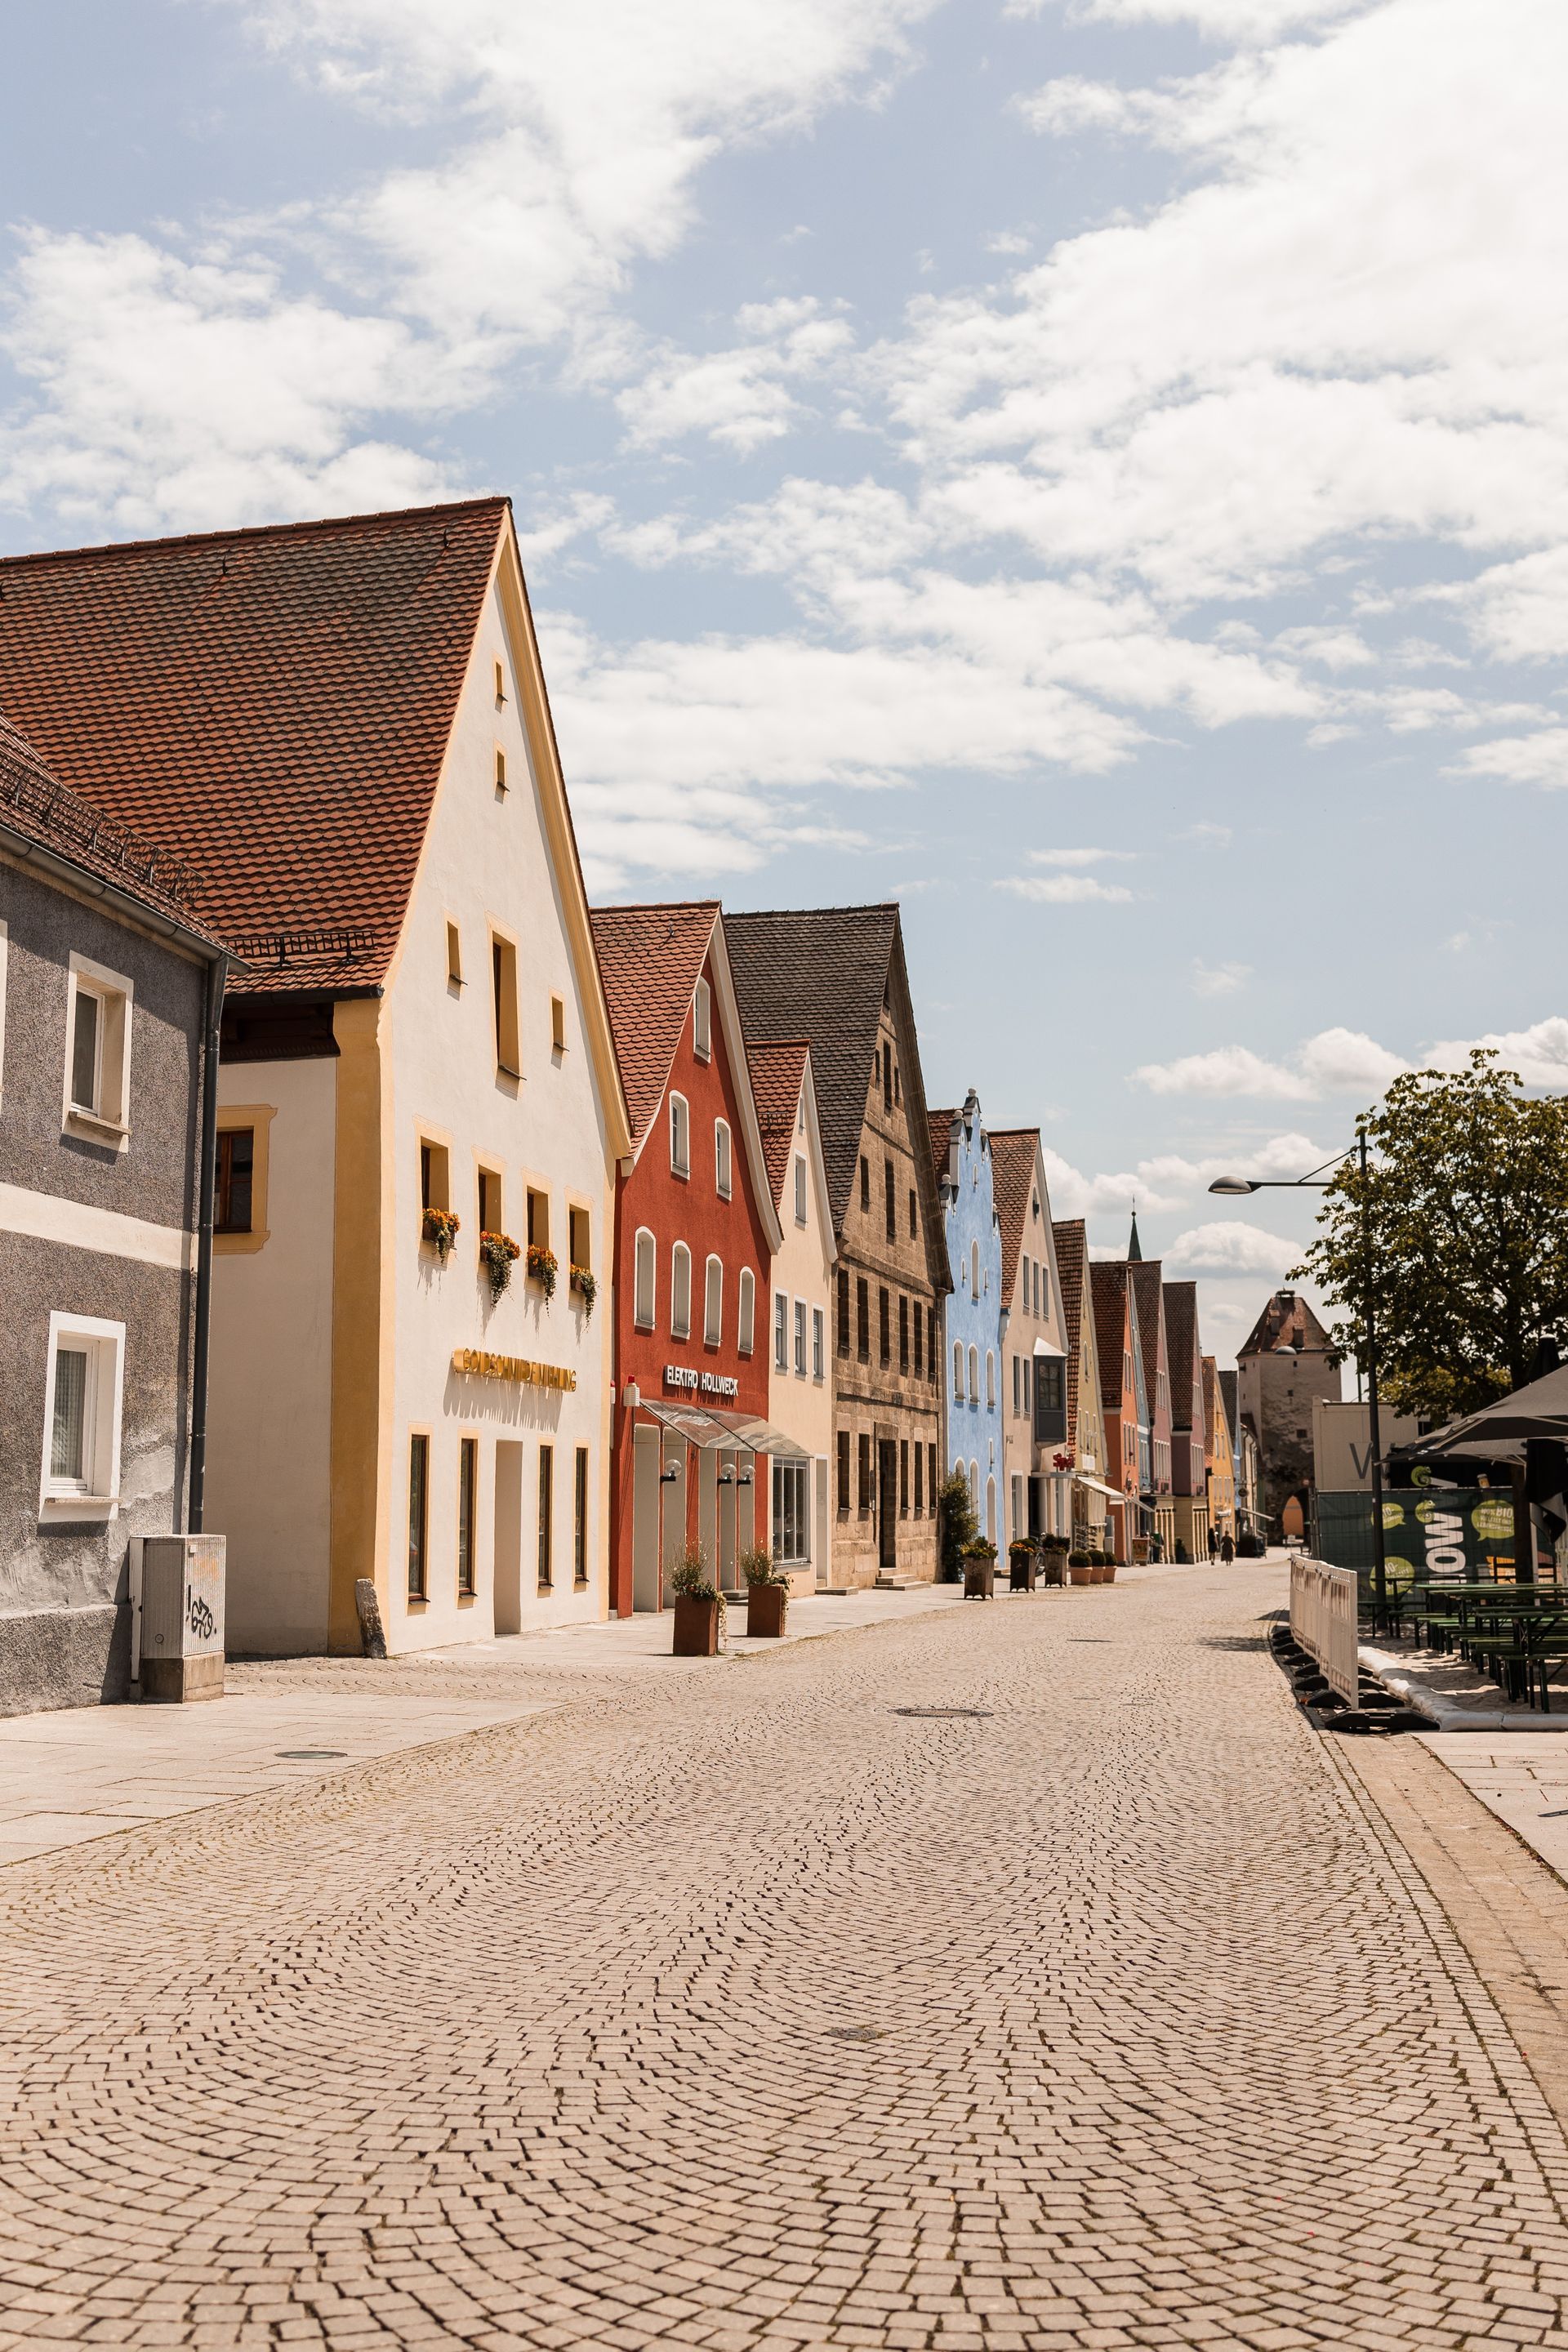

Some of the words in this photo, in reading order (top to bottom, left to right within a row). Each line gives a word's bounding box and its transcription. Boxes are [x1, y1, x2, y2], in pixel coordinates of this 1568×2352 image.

[455, 1348, 538, 1386] GOLDSCHMIEDE
[666, 1365, 698, 1389] ELEKTRO
[701, 1372, 739, 1396] HOLLWECK
[1495, 1505, 1513, 1518] BIO
